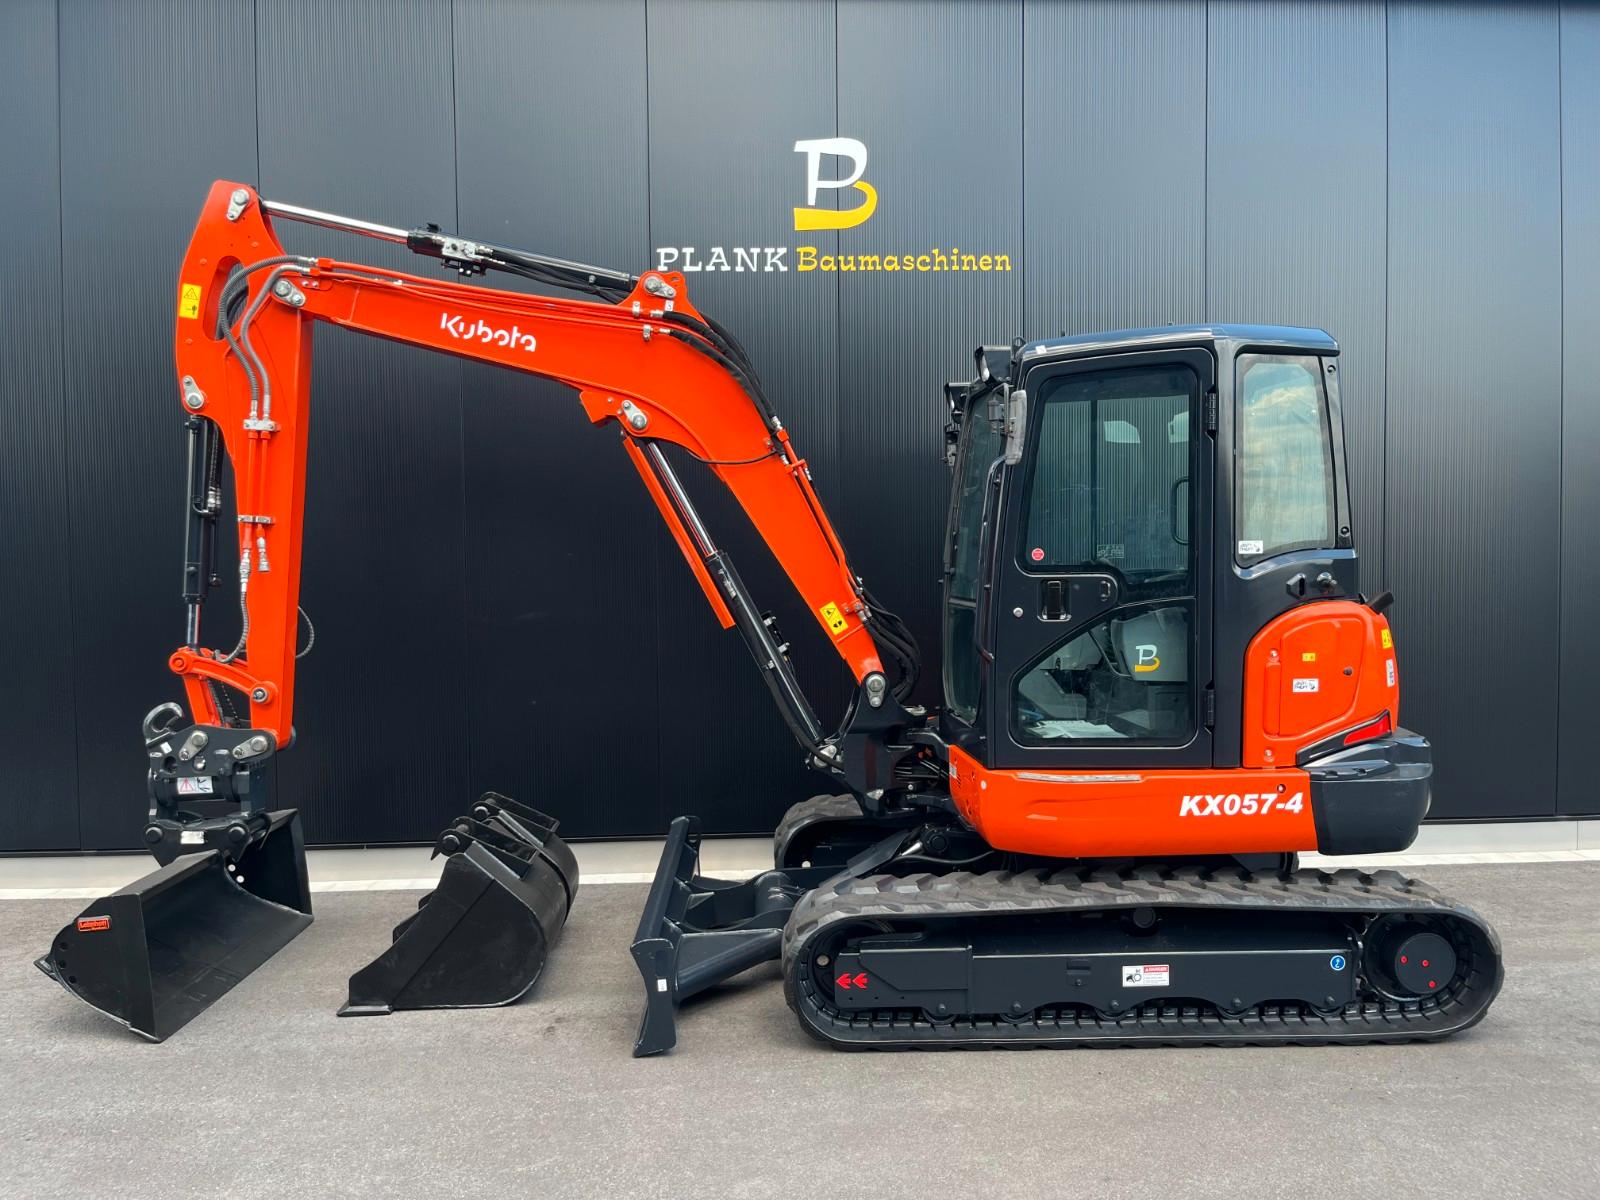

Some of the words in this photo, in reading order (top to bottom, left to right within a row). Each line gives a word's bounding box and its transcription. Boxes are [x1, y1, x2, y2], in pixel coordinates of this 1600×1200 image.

[656, 246, 788, 272] PLANK
[796, 246, 1011, 272] Baumaschinen
[440, 312, 537, 352] Kubota
[1179, 792, 1303, 817] KX057-4
